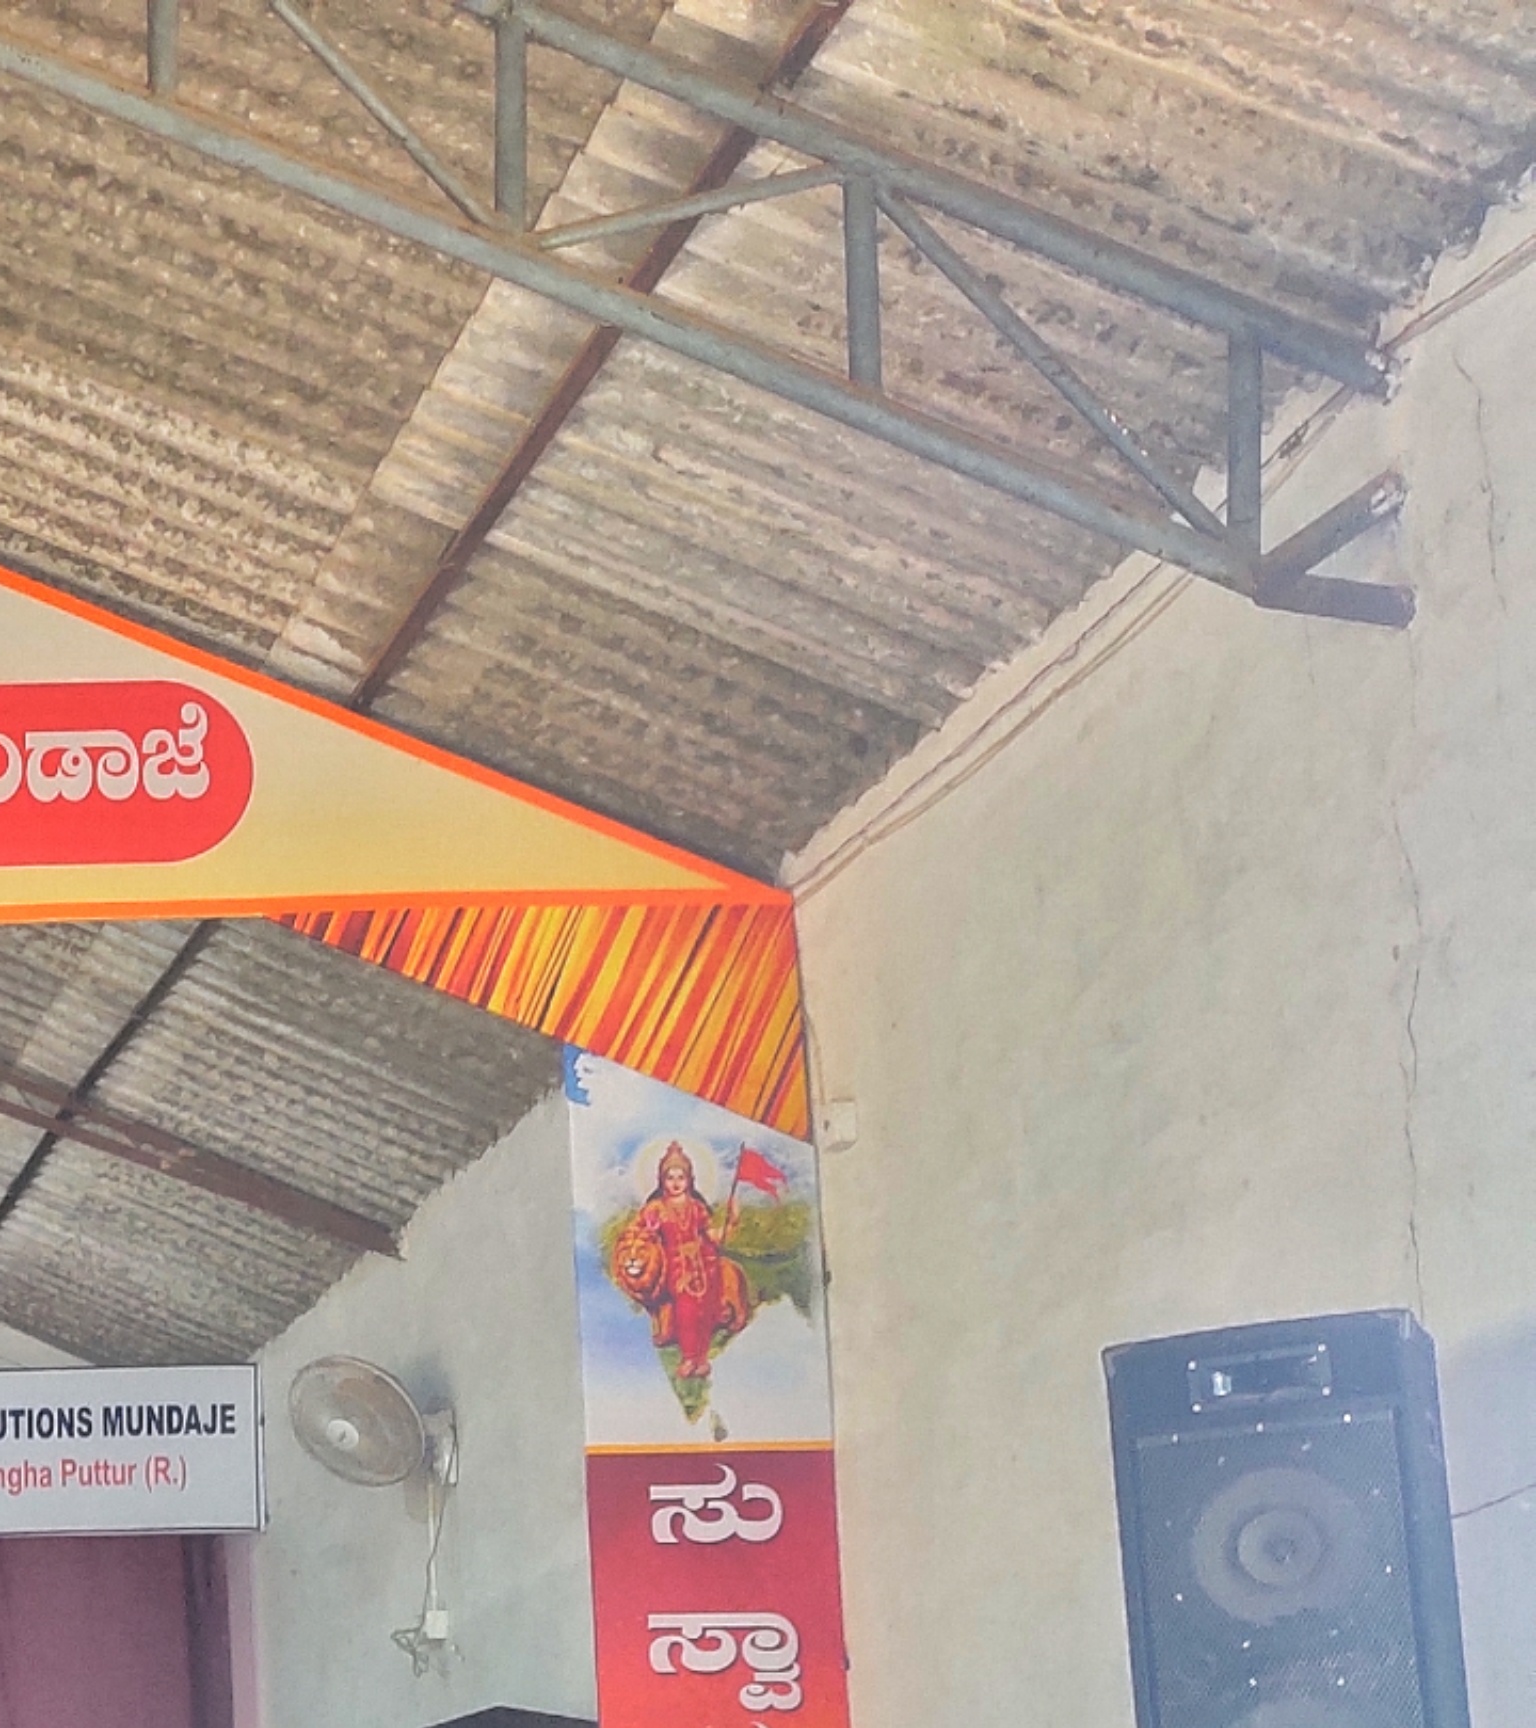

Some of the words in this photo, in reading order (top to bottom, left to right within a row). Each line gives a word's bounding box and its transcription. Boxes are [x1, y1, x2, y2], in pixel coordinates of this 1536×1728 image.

[103, 1404, 235, 1436] MUNDAJE
[62, 1459, 137, 1486] Puttur
[145, 1456, 186, 1493] (R.)
